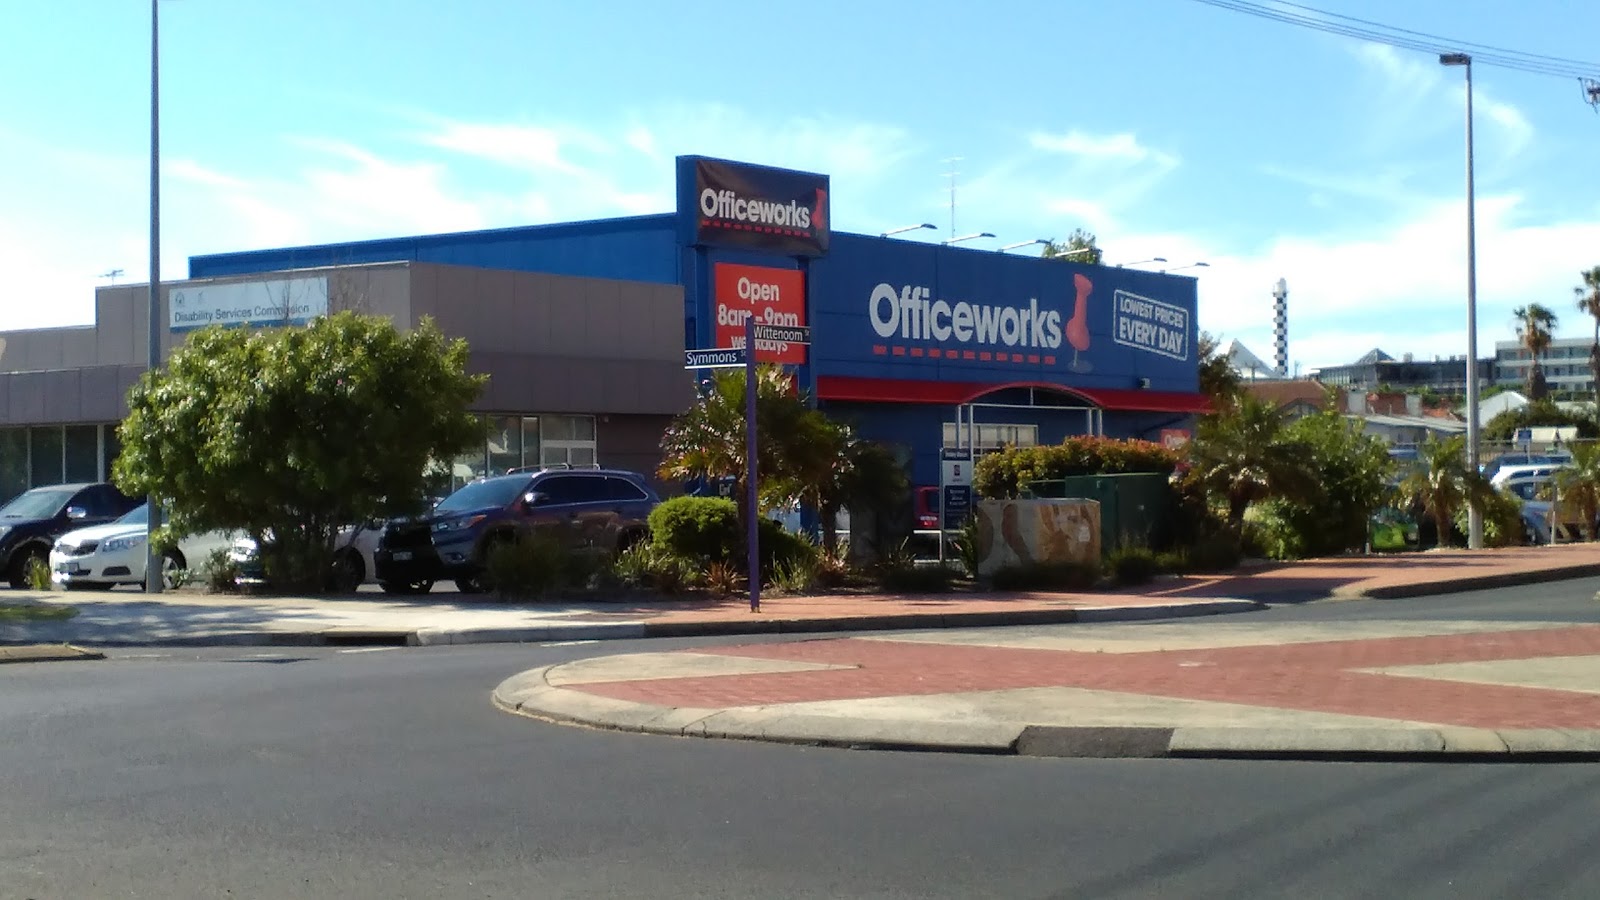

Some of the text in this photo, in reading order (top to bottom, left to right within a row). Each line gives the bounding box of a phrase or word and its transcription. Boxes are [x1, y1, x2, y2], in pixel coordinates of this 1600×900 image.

[701, 188, 810, 229] Officeworks
[737, 276, 779, 304] Open
[175, 304, 310, 323] Disability Services Commsion
[869, 283, 1062, 349] Officeworks
[1120, 297, 1184, 328] LOWEST PRICES
[731, 336, 788, 355] wekdays
[754, 326, 803, 342] Wittenoom
[1119, 316, 1183, 354] EVERY DAY
[686, 351, 737, 366] Symmons
